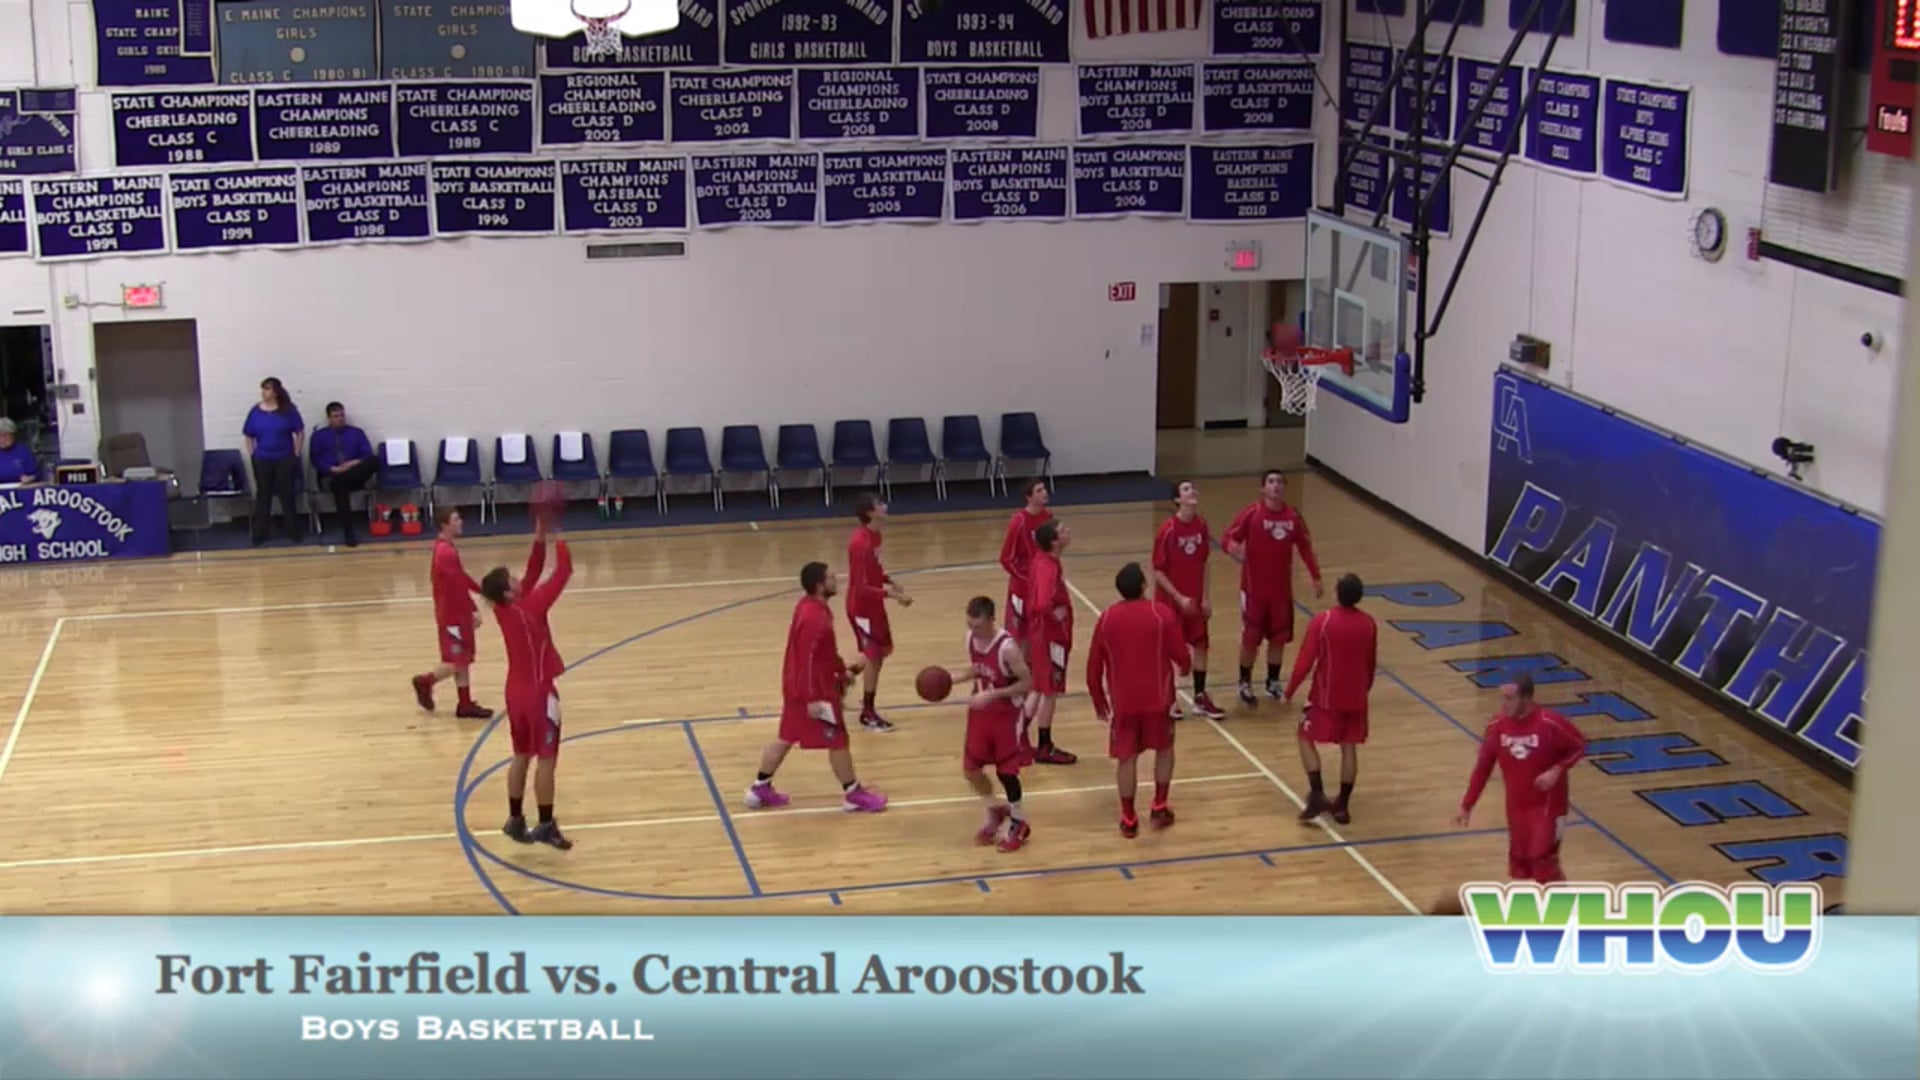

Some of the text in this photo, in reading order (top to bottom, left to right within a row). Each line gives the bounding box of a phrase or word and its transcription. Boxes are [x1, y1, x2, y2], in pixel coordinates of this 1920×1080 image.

[276, 28, 316, 39] GIRLS
[438, 24, 478, 35] GIRLS
[751, 41, 867, 59] GIRLS BASKETBALL
[927, 40, 1043, 57] BOYS BASKETBALL
[823, 71, 893, 82] REGIONAL
[926, 72, 1037, 84] STATE CHAMPIONS
[1080, 66, 1193, 78] EASTERN MAINE
[567, 75, 637, 88] REGIONAL
[671, 75, 792, 89] STATE CHAMPIONS
[1095, 80, 1177, 92] CHAMPIONS
[398, 89, 532, 101] STATE CHAMPIONS
[564, 88, 641, 101] CHAMPION
[818, 84, 899, 96] CHAMPIONS
[935, 89, 1029, 101] CHEERLEADING
[1238, 83, 1314, 94] BASKETBALL
[114, 94, 248, 109] STATE CHAMPIONS
[258, 92, 388, 106] EASTERN MAINE
[679, 91, 783, 105] CHEERLEADING
[808, 98, 908, 110] CHEERLEADING
[1115, 92, 1193, 104] BASKETBALL
[1231, 97, 1287, 109] CLASS D
[410, 105, 519, 117] CHEERLEADING
[549, 101, 656, 114] CHEERLEADING
[701, 106, 762, 120] CLASS D
[954, 104, 1010, 115] CLASS D
[1107, 106, 1167, 118] CLASS D
[1546, 101, 1570, 116] CLASS
[126, 113, 237, 128] CHEERLEADING
[280, 108, 368, 121] CHAMPIONS
[572, 114, 633, 127] CLASS D
[828, 111, 889, 124] CLASS D
[269, 124, 379, 139] CHEERLEADING
[431, 120, 499, 132] CLASS C
[715, 123, 749, 136] 2002
[842, 125, 875, 136] 2008
[149, 131, 217, 146] CLASS C
[585, 130, 620, 140] 2002
[309, 142, 341, 153] 1989
[449, 137, 481, 148] 1989
[952, 149, 1065, 162] EASTERN MAINE
[1075, 151, 1184, 163] STATE CHAMPIONS
[1625, 145, 1662, 165] CLASS C
[563, 159, 685, 174] EASTERN MAINE
[694, 156, 816, 170] EASTERN MAINE
[825, 155, 945, 169] STATE CHAMPIONS
[303, 165, 427, 181] EASTERN MAINE
[433, 166, 555, 178] STATE CHAMPIONS
[969, 163, 1051, 176] CHAMPIONS
[1076, 166, 1183, 178] BOYS BASKETBALL
[1216, 164, 1288, 174] CHAMPIONS
[172, 175, 296, 191] STATE CHAMPIONS
[580, 175, 669, 187] CHAMPIONS
[712, 170, 798, 183] CHAMPIONS
[825, 171, 944, 186] BOYS BASKETBALL
[33, 177, 163, 194] EASTERN MAINE
[322, 180, 410, 195] CHAMPIONS
[433, 182, 554, 193] BOYS BASKETBALL
[696, 183, 816, 198] BOYS BASKETBALL
[954, 177, 1066, 191] BOYS BASKETBALL
[1103, 180, 1158, 192] CLASS D
[588, 188, 661, 200] BASEBALL
[853, 186, 915, 198] CLASS D
[981, 191, 1039, 202] CLASS D
[1225, 191, 1279, 202] CLASS D
[52, 193, 144, 209] CHAMPIONS
[174, 192, 297, 208] BOYS BASKETBALL
[307, 195, 427, 210] BOYS BASKETBALL
[463, 198, 525, 209] CLASS D
[726, 196, 787, 208] CLASS D
[594, 201, 657, 214] CLASS D
[37, 206, 161, 224] BOYS BASKETBALL
[207, 210, 268, 223] CLASS D
[338, 210, 399, 222] CLASS D
[478, 214, 508, 225] 1996
[609, 216, 643, 227] 2003
[69, 222, 132, 237] CLASS D
[1111, 283, 1134, 299] EXIT
[34, 488, 134, 542] AROOSTOOK
[38, 539, 109, 558] SCHOOL
